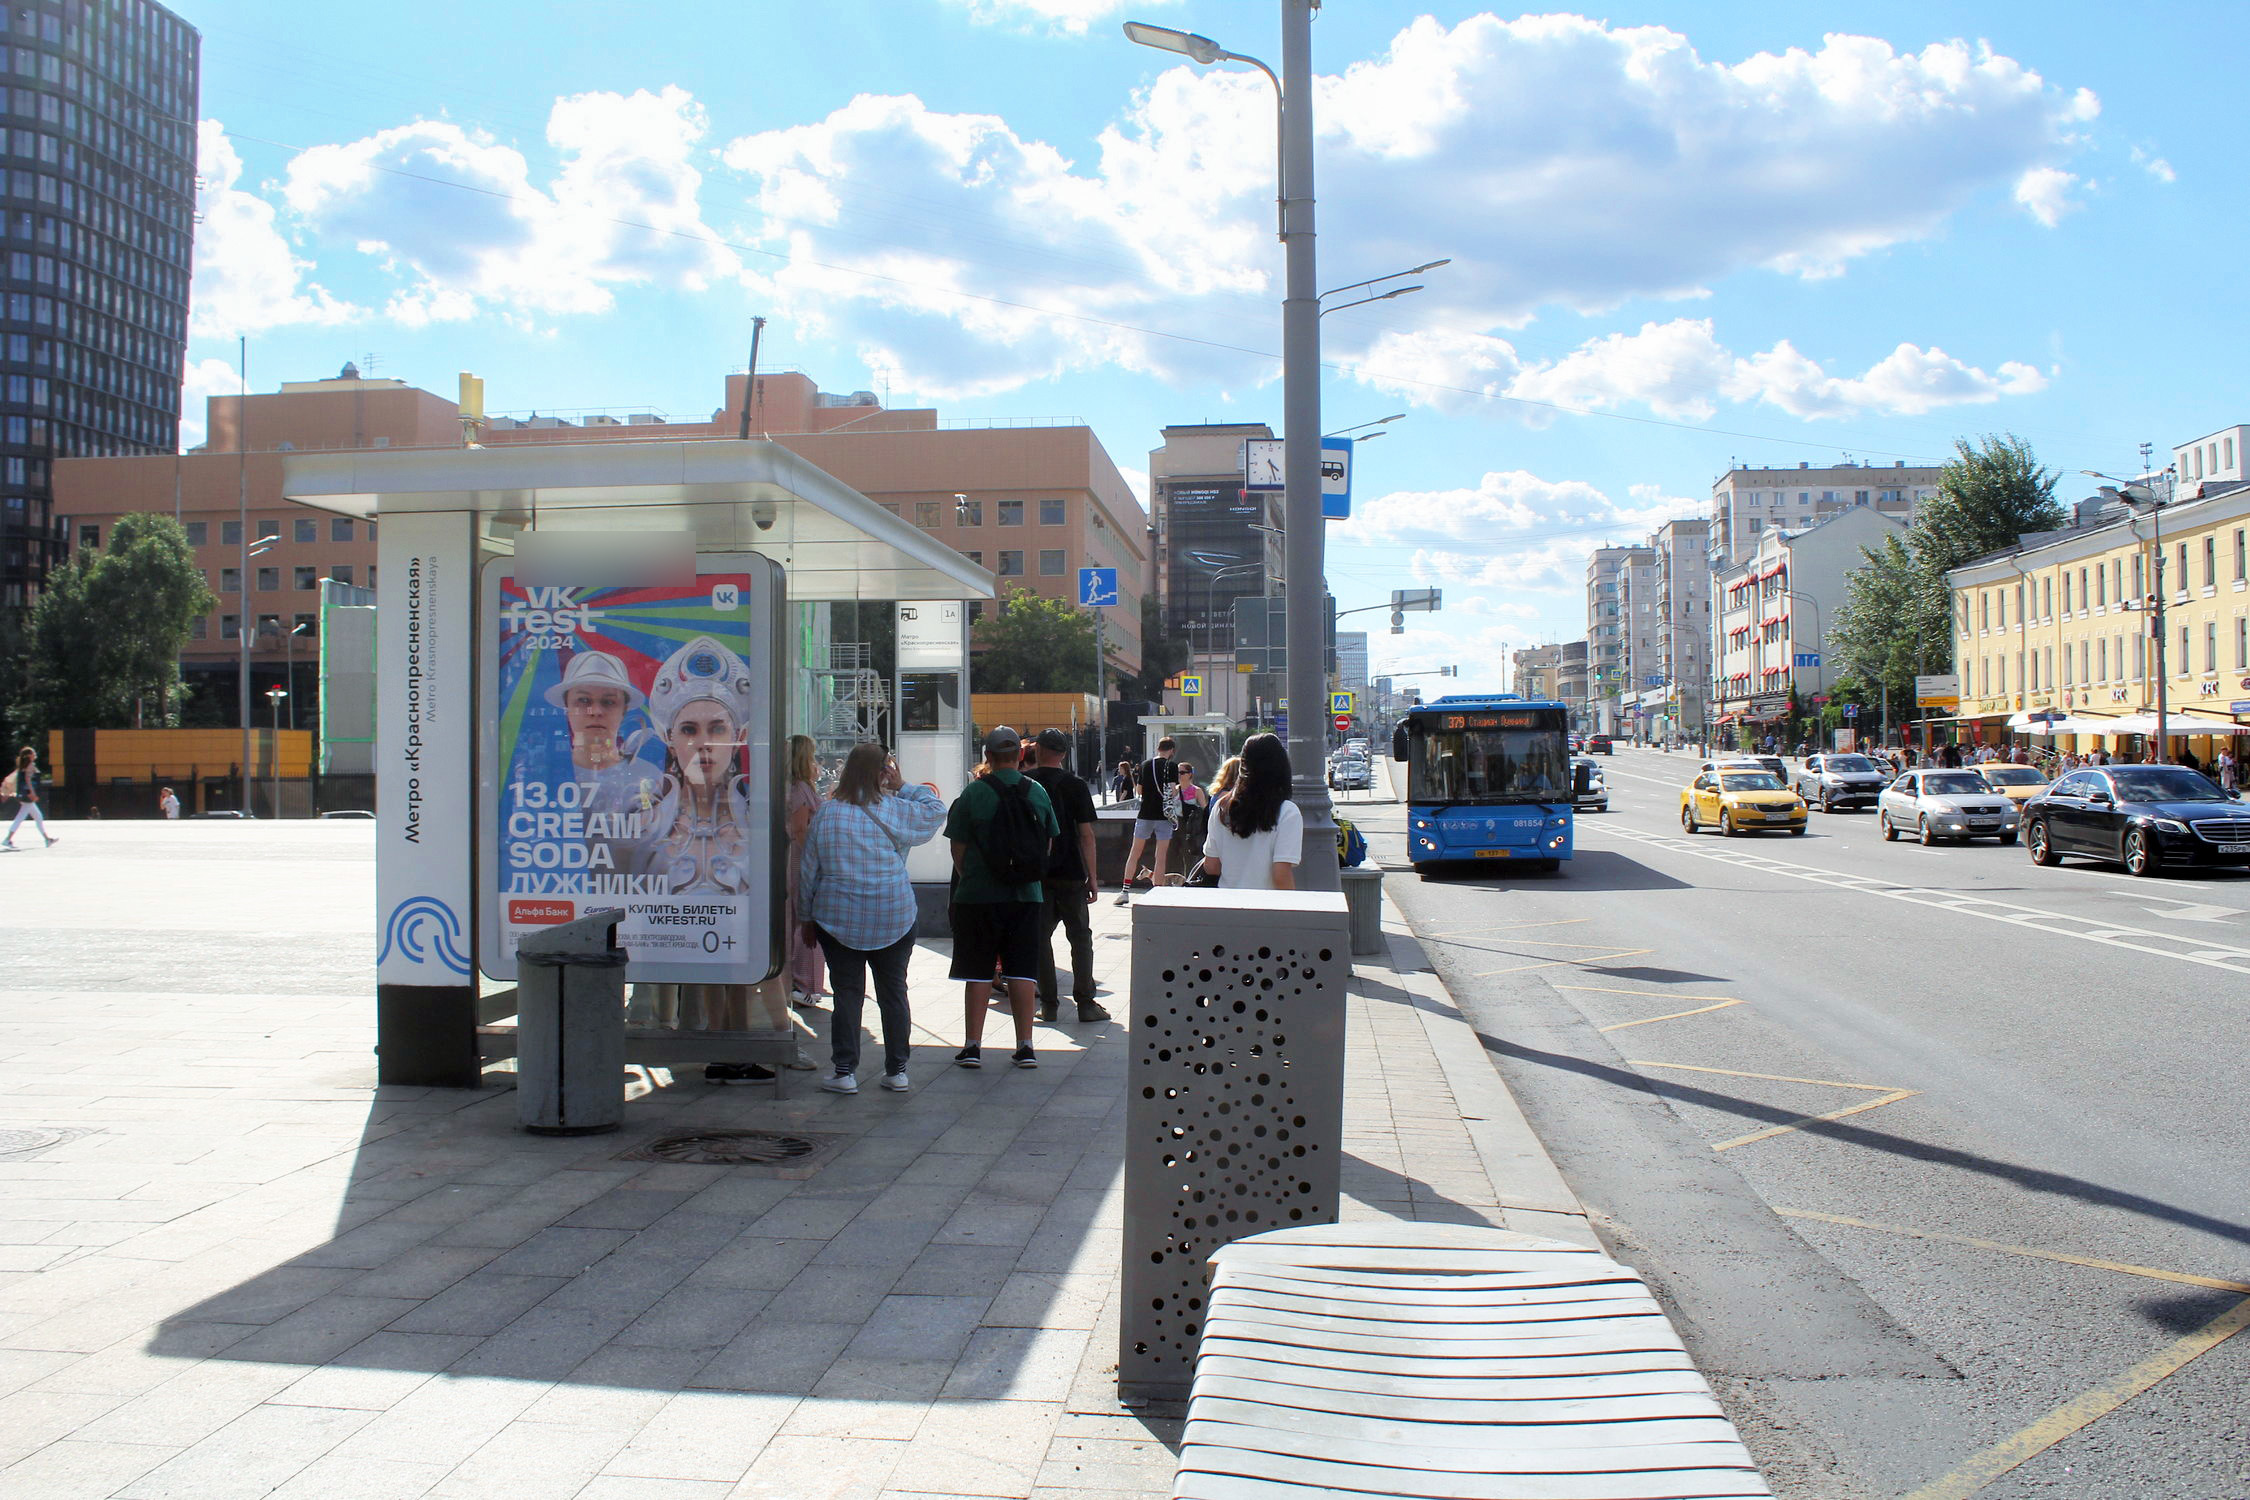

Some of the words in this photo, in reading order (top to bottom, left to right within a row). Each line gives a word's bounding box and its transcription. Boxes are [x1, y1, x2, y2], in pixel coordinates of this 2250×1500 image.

[525, 586, 578, 608] VK
[716, 592, 734, 604] VK
[426, 556, 439, 680] Krasnopresnenskaya
[500, 602, 605, 633] fest
[526, 635, 575, 650] 2024
[405, 557, 422, 771] «Краснопресненская»
[2112, 688, 2127, 701] KFC
[2200, 681, 2218, 695] KFC
[426, 684, 437, 722] Metro
[1448, 716, 1464, 728] 379
[509, 782, 600, 808] 13.07
[405, 778, 423, 843] Метро
[509, 812, 641, 839] CREAM
[509, 842, 615, 869] SODA
[508, 873, 669, 896] ЛУЖНИКИ
[515, 907, 544, 918] Альфа
[545, 907, 568, 916] Банк
[628, 904, 679, 914] КУПИТЬ
[682, 905, 736, 915] БИЛЕТЫ
[648, 915, 716, 926] VKFEST.RU
[703, 931, 736, 953] 0+
